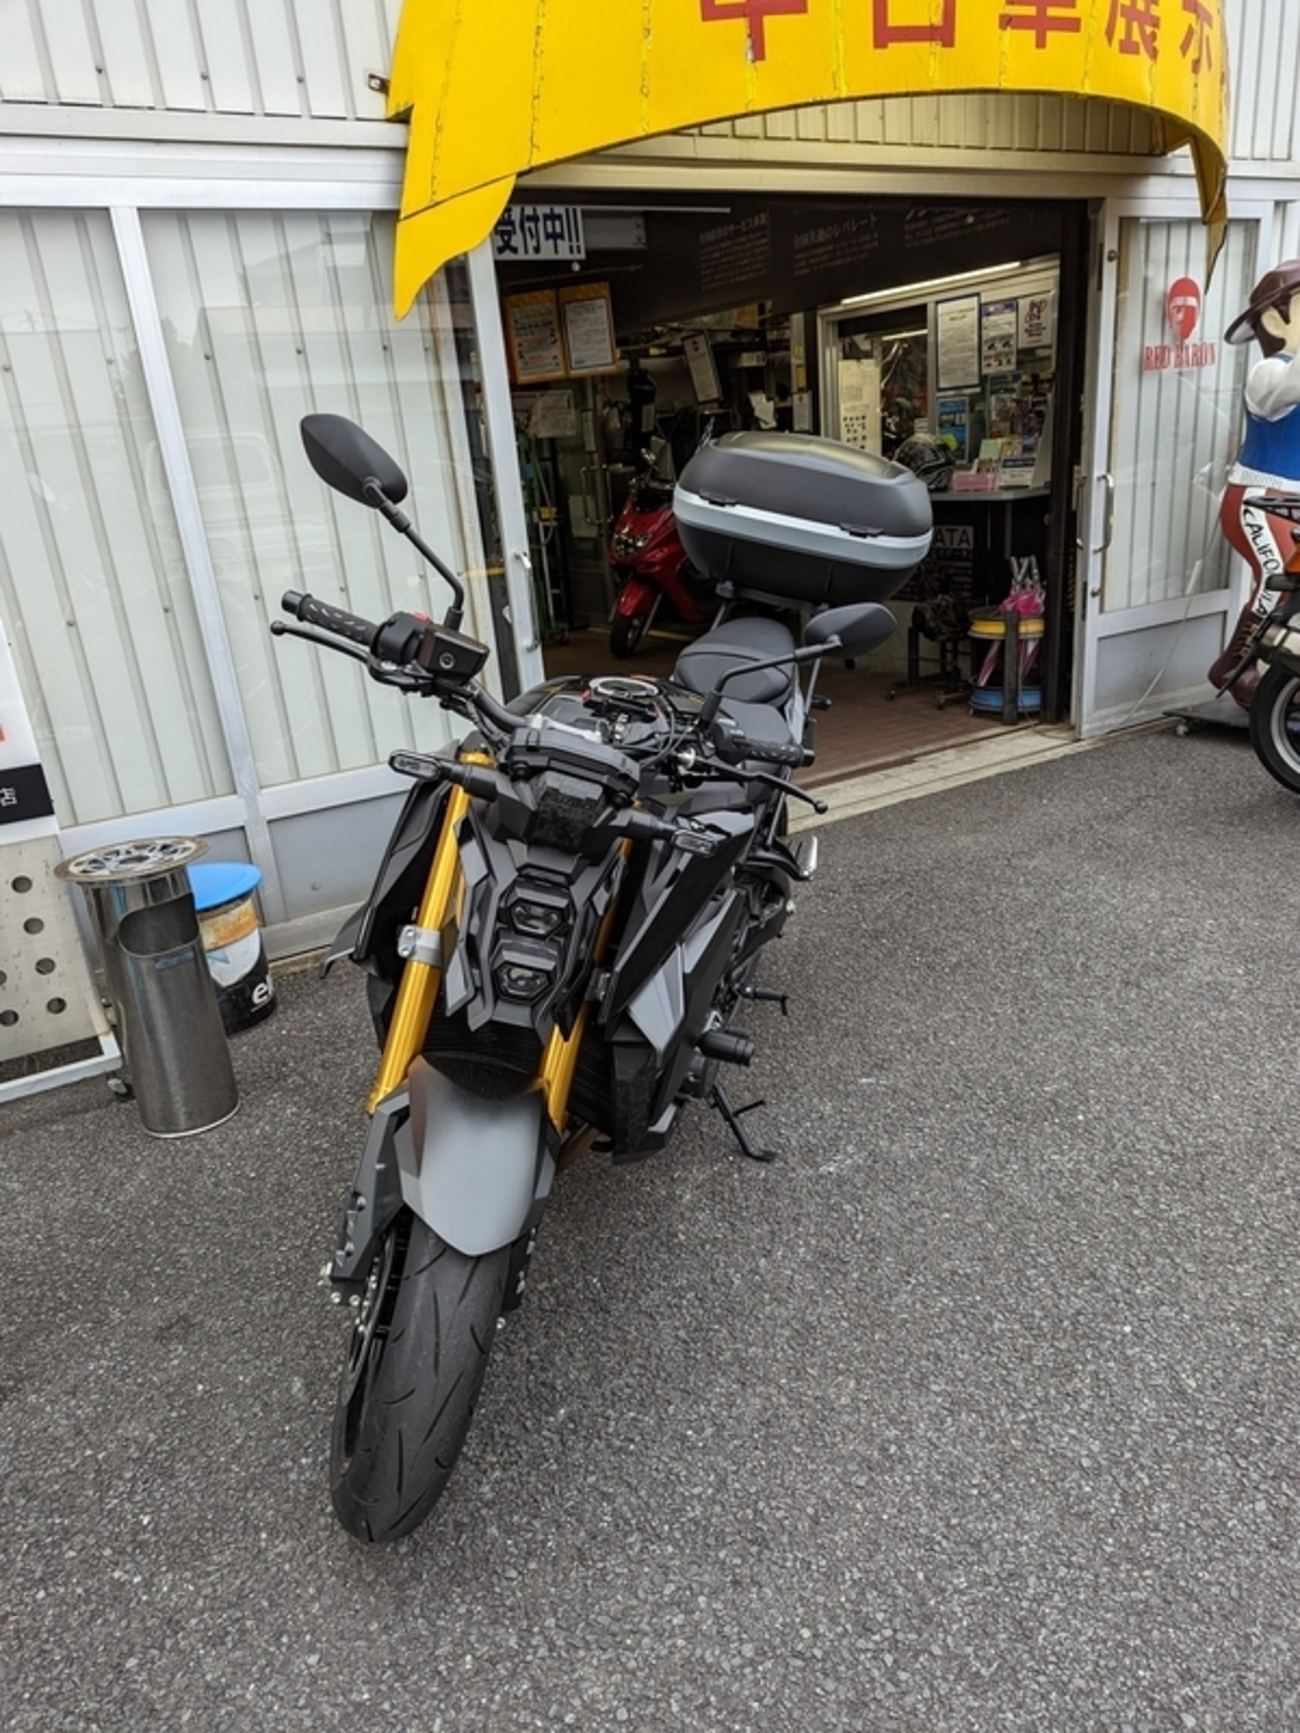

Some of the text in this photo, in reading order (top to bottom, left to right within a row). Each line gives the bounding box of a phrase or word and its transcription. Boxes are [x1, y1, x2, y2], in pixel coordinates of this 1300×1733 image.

[494, 206, 581, 255] 受付中!!
[1144, 345, 1170, 371] RED
[1243, 508, 1281, 615] CALIFOIA
